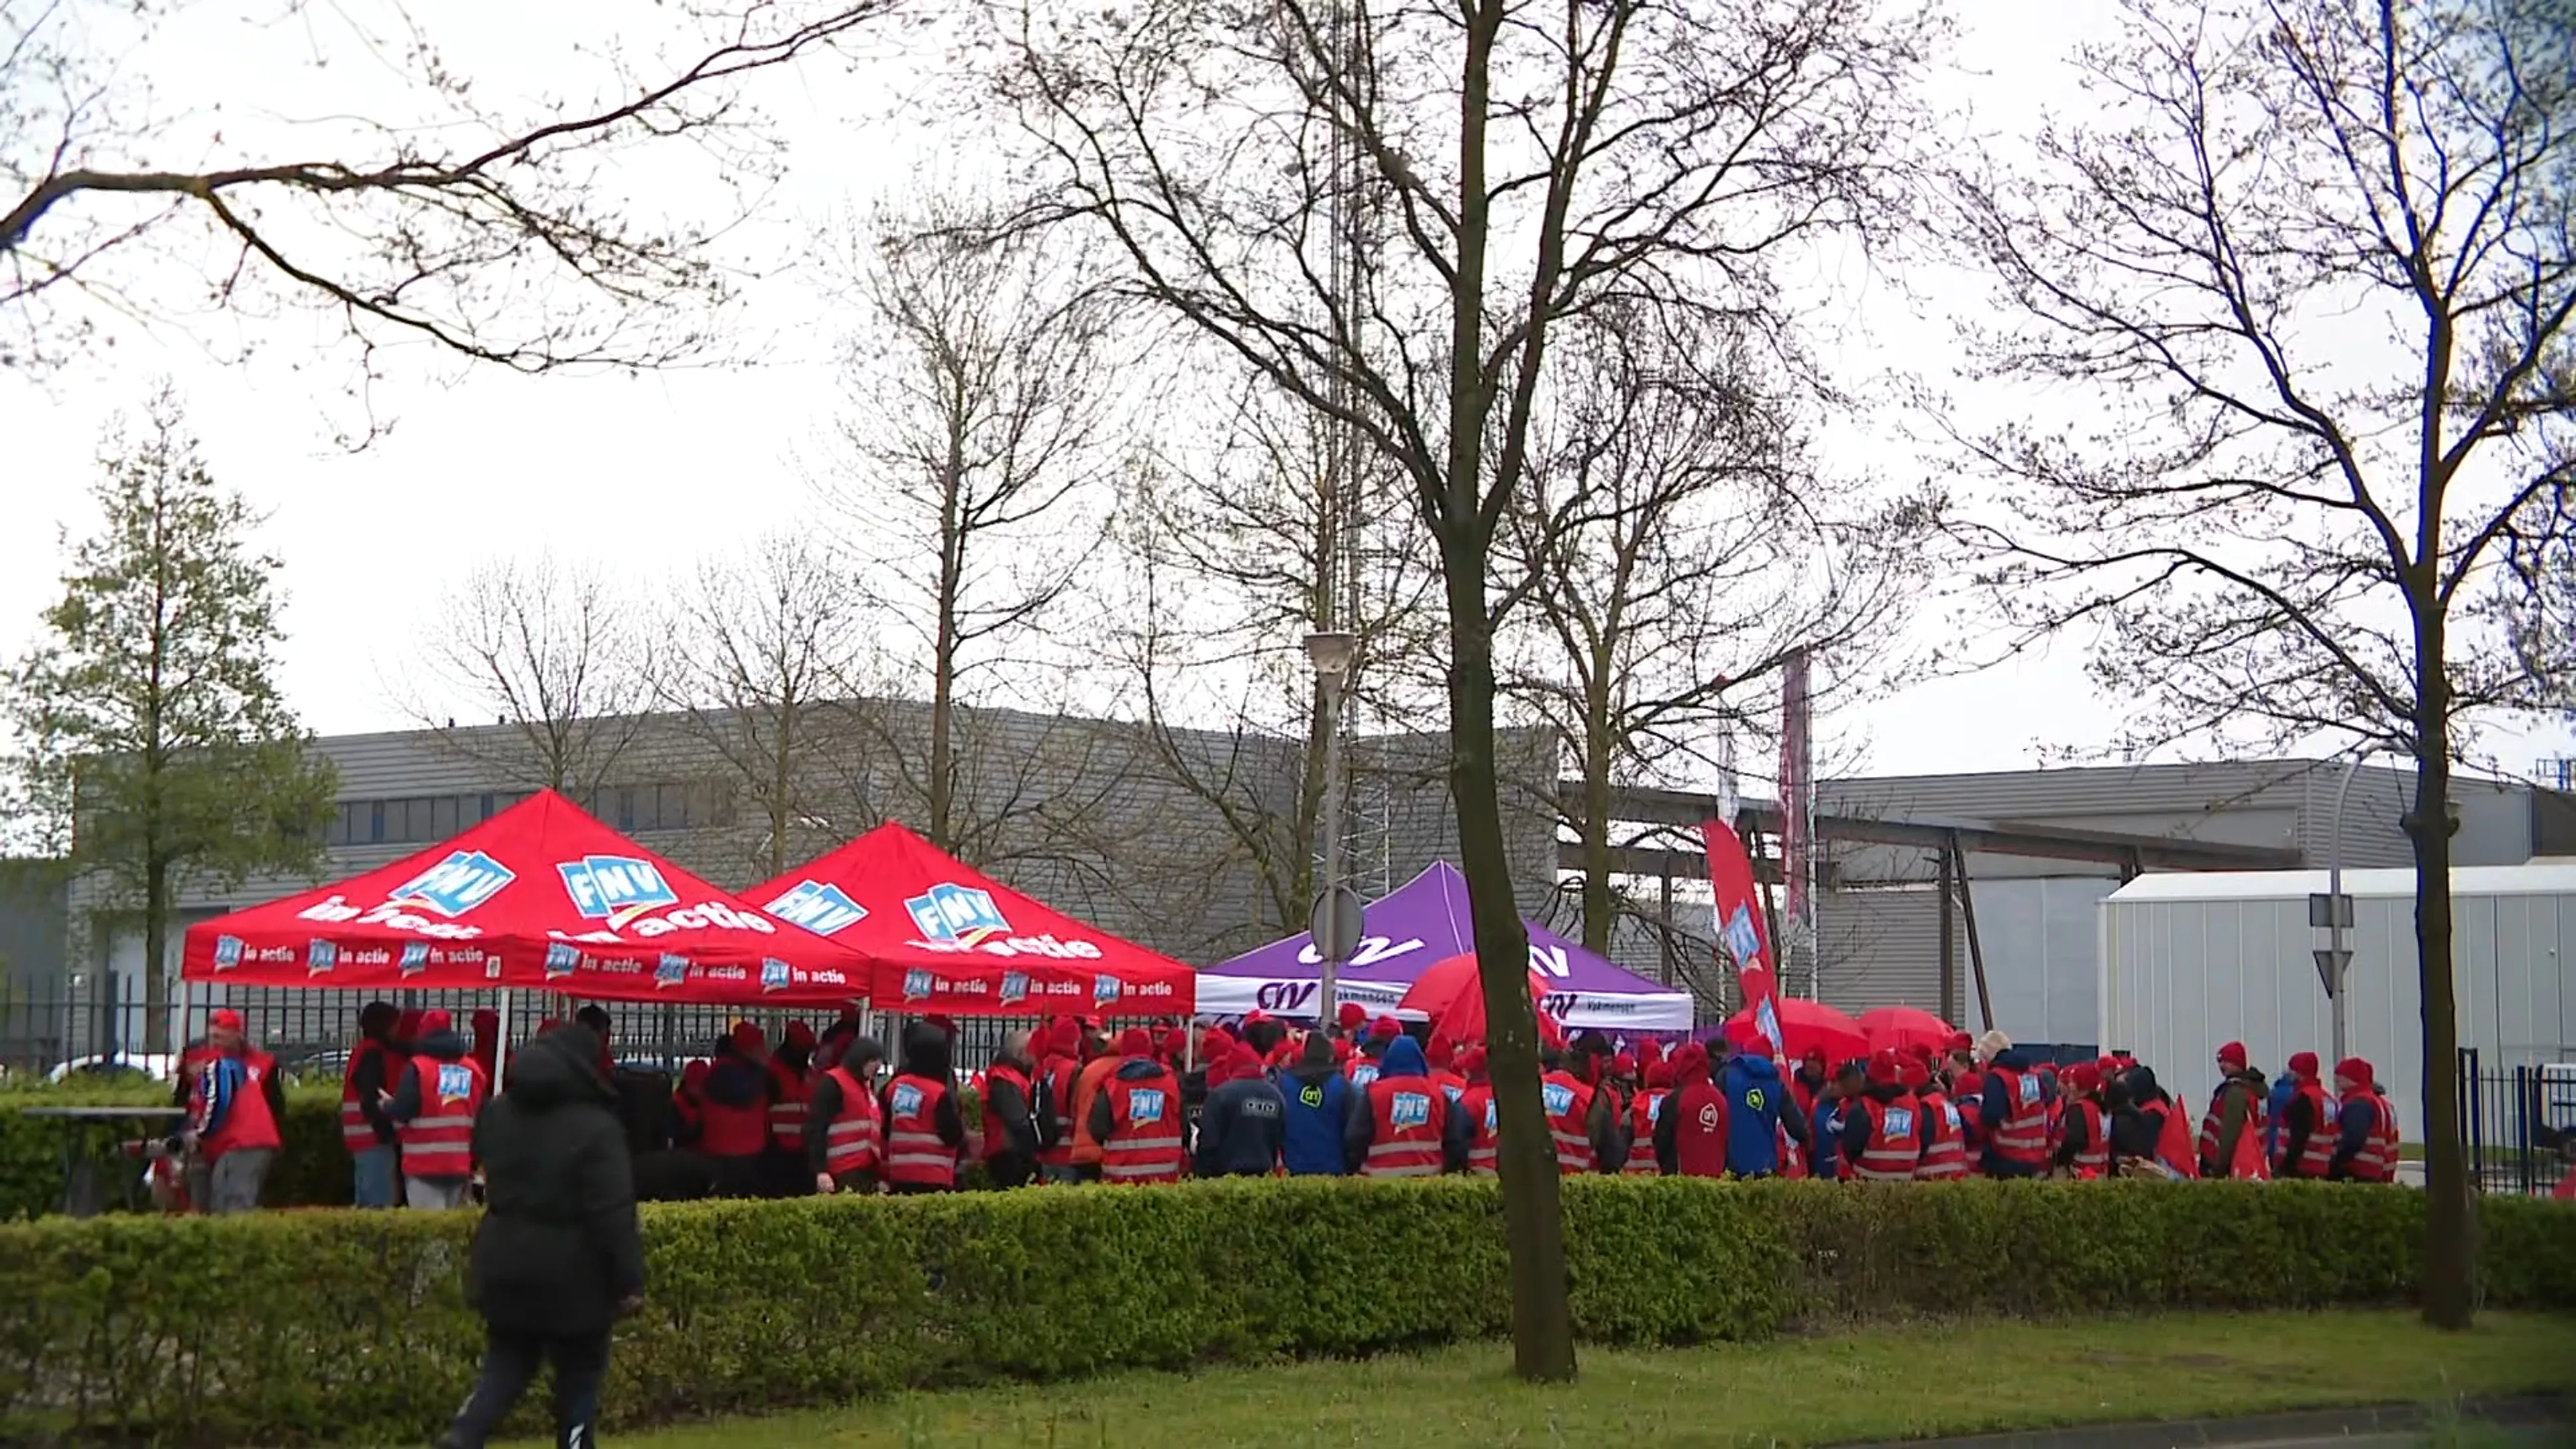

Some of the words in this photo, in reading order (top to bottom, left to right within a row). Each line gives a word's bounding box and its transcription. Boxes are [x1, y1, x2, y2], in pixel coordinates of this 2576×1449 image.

[570, 865, 660, 907] FNV
[631, 900, 776, 937] actie
[916, 892, 996, 936] FNV
[244, 944, 257, 961] in
[260, 945, 295, 962] actie
[339, 947, 353, 963] in
[356, 947, 390, 964] actie
[430, 947, 444, 963] in
[448, 946, 484, 963] actie
[1297, 936, 1426, 966] CV
[581, 953, 598, 970] in
[602, 957, 642, 973] actie
[792, 965, 808, 982] in
[811, 968, 847, 984] actie
[935, 976, 950, 993] in
[953, 977, 987, 994] actie
[1030, 979, 1043, 994] in
[1046, 978, 1081, 996] actie
[1123, 982, 1136, 996] in
[1140, 980, 1173, 996] actie
[1392, 1096, 1428, 1120] FNV
